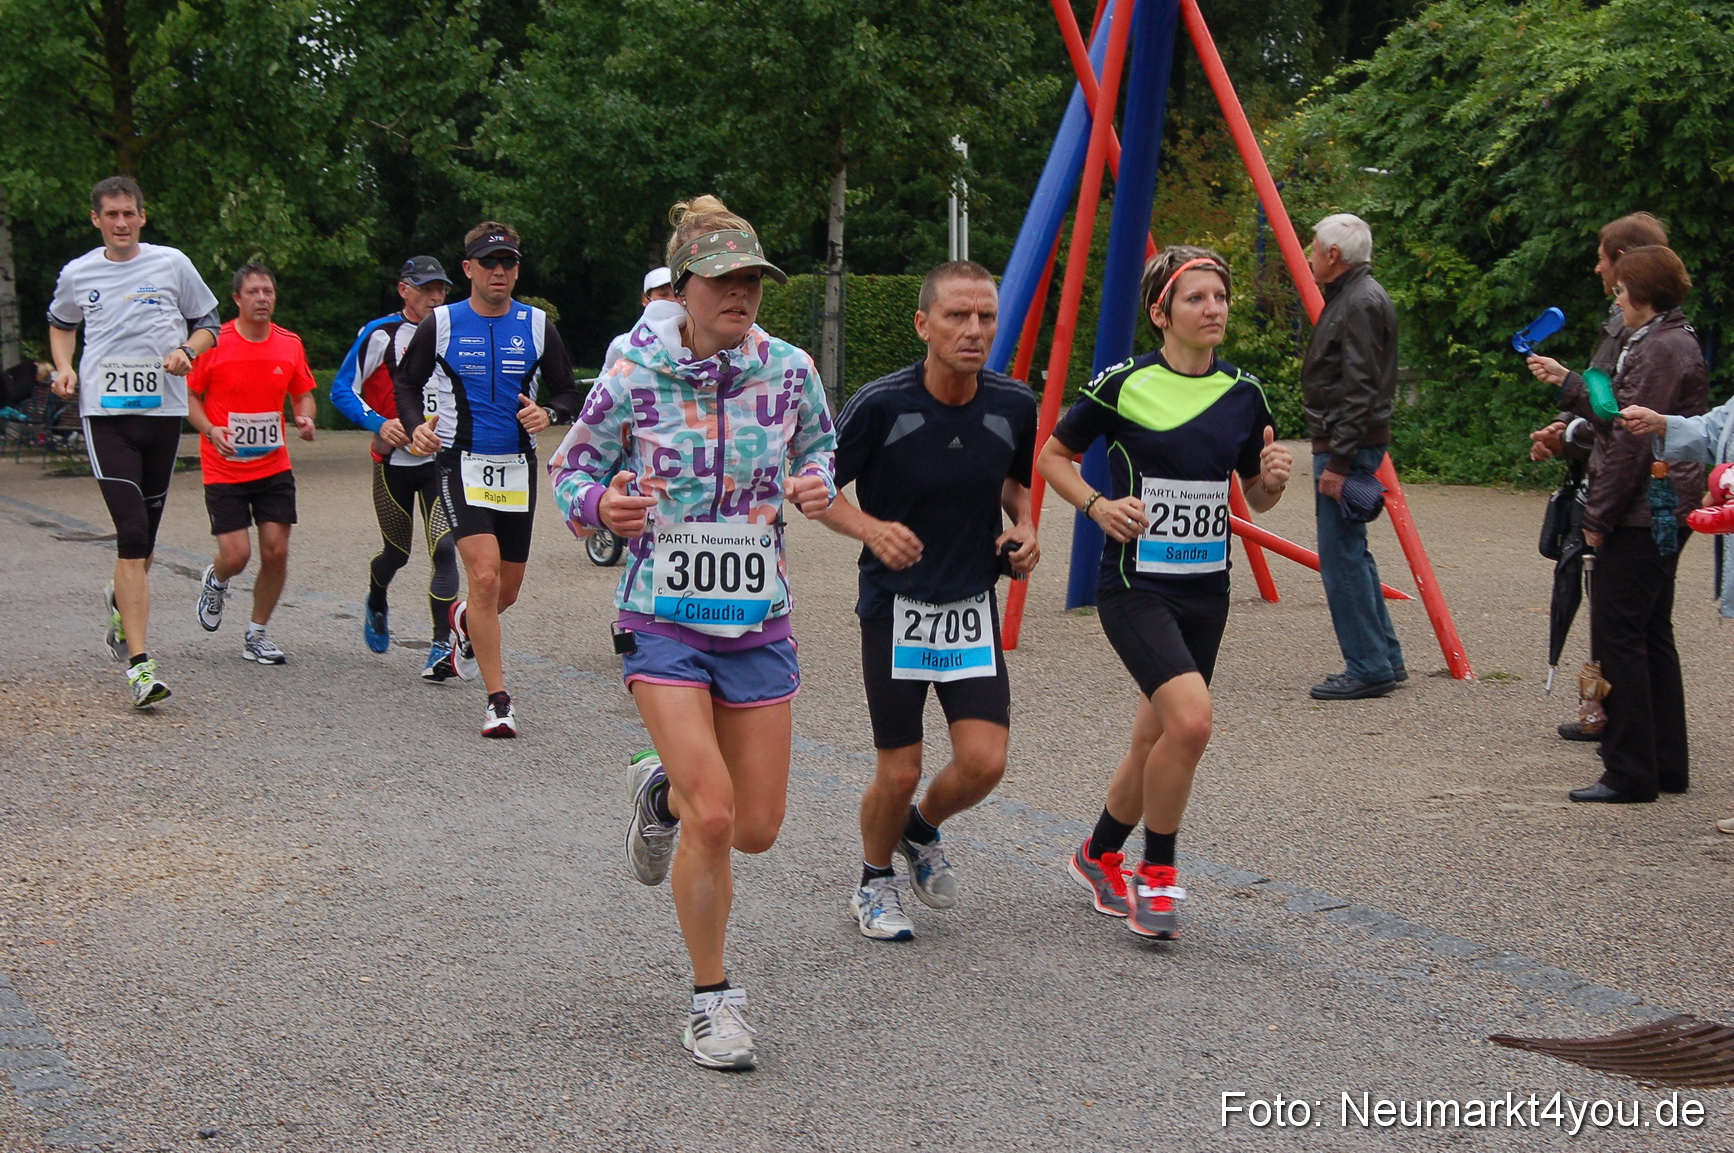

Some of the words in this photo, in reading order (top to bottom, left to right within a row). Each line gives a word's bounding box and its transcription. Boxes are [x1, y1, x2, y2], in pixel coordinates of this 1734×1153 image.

[105, 371, 157, 392] 2168
[235, 424, 278, 444] 2019
[482, 465, 506, 487] 81
[484, 491, 507, 503] Ralph
[1143, 487, 1177, 499] PARTL
[1179, 491, 1224, 500] Neumarkt
[1149, 502, 1227, 538] 2588
[657, 533, 698, 544] PARTL
[701, 534, 756, 546] Neumarkt
[1166, 546, 1208, 560] Sandra
[666, 550, 765, 593] 3009
[685, 602, 745, 621] Claudia
[904, 607, 982, 644] 2709
[921, 652, 963, 668] Harald
